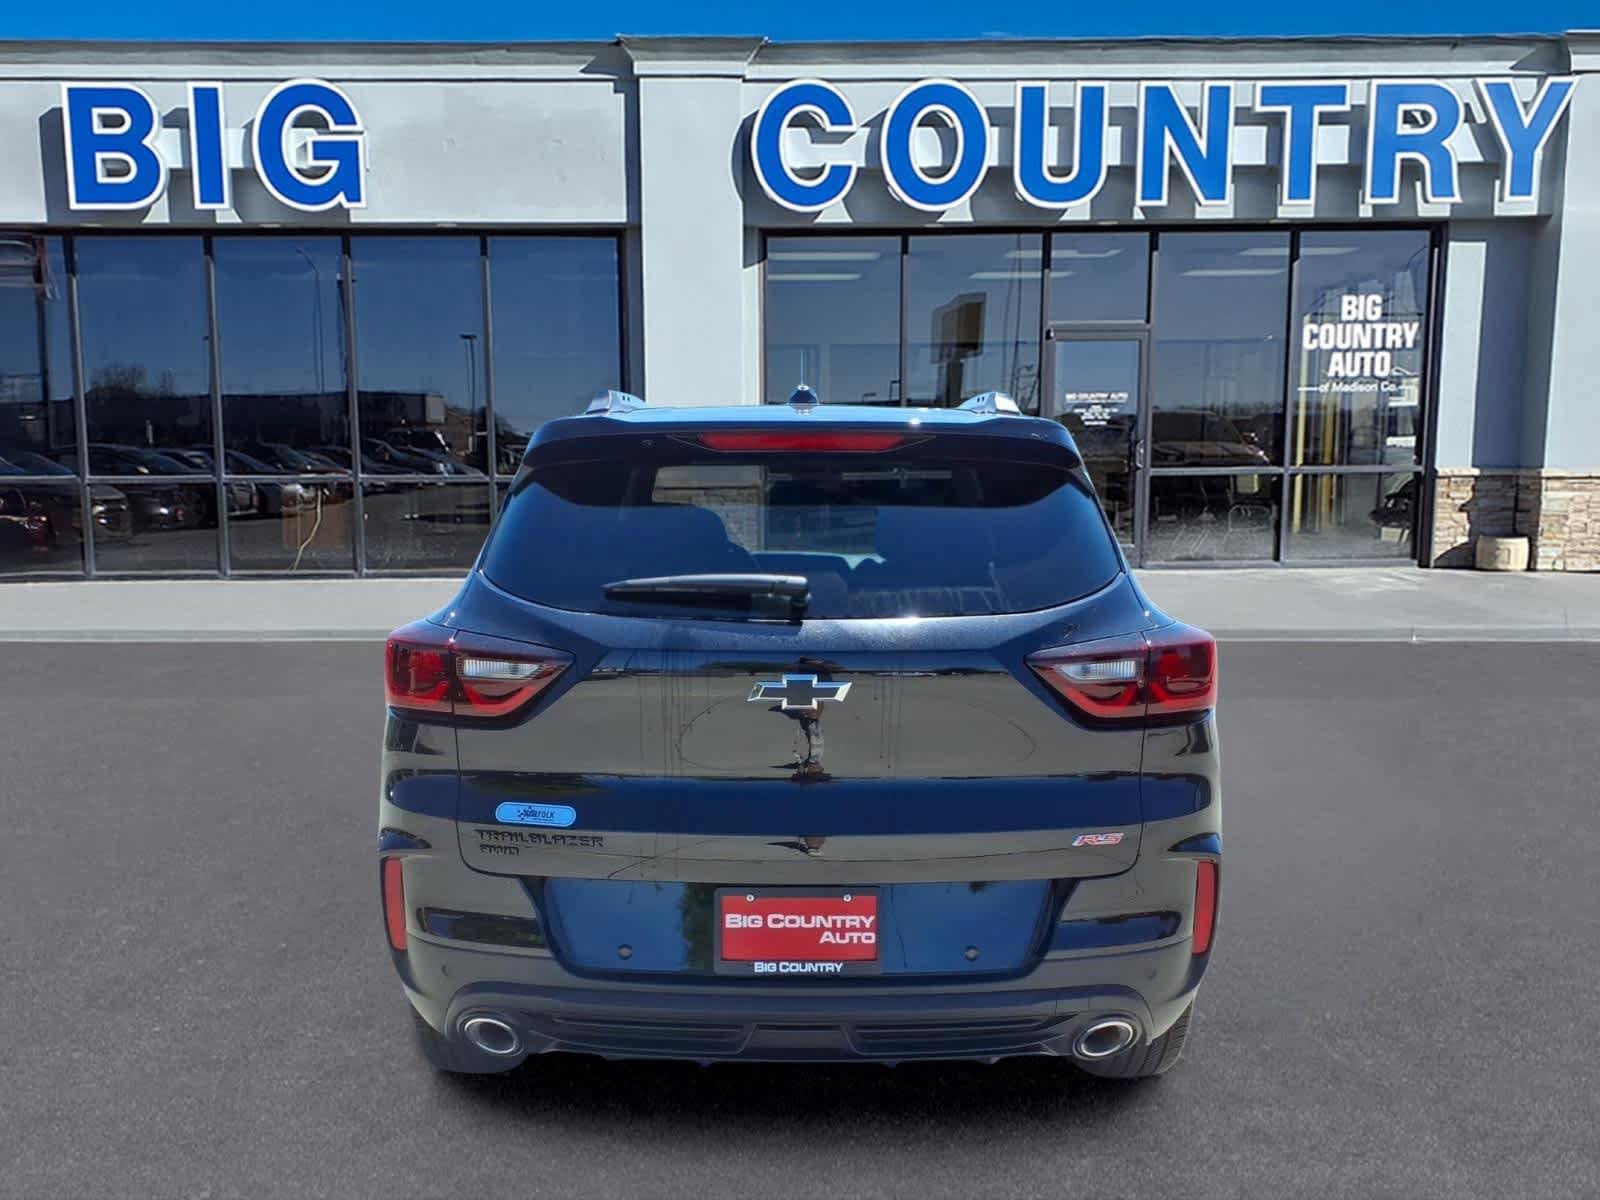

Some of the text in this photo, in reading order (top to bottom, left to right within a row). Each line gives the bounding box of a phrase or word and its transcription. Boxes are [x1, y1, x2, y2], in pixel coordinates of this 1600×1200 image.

[61, 78, 1574, 213] BIG COUNTRY
[1341, 294, 1382, 321] BIG
[1303, 322, 1419, 350] COUNTRY
[1328, 351, 1391, 378] AUTO
[1332, 381, 1377, 392] Madison
[475, 829, 604, 847] TRAILBLAZER
